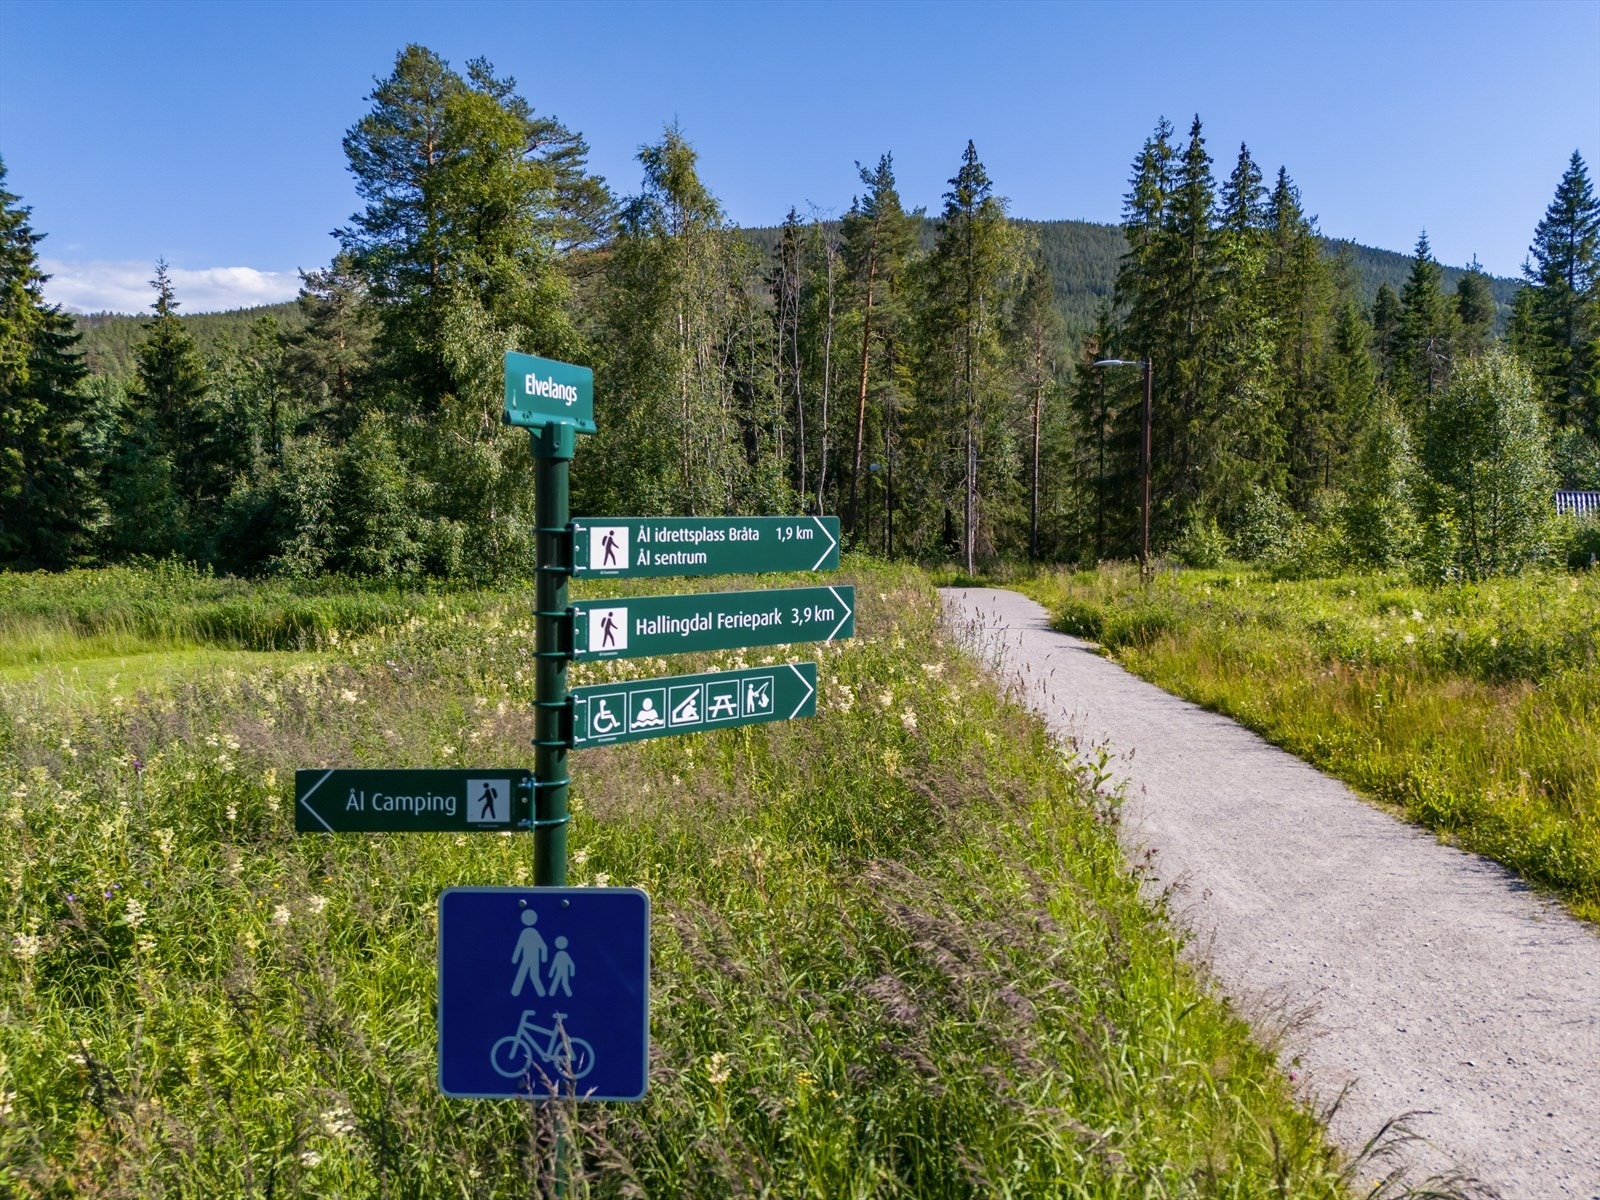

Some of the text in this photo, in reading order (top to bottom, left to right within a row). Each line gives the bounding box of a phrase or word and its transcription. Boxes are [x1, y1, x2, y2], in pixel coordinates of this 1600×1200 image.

[525, 372, 578, 407] Elvelangs
[636, 525, 814, 546] Ål idrettsplass Bråta 1,9 km
[636, 548, 707, 566] Ål sentrum
[636, 604, 835, 637] Hallingdal Feriepark 3,9 km
[346, 788, 457, 816] Ål Camping
